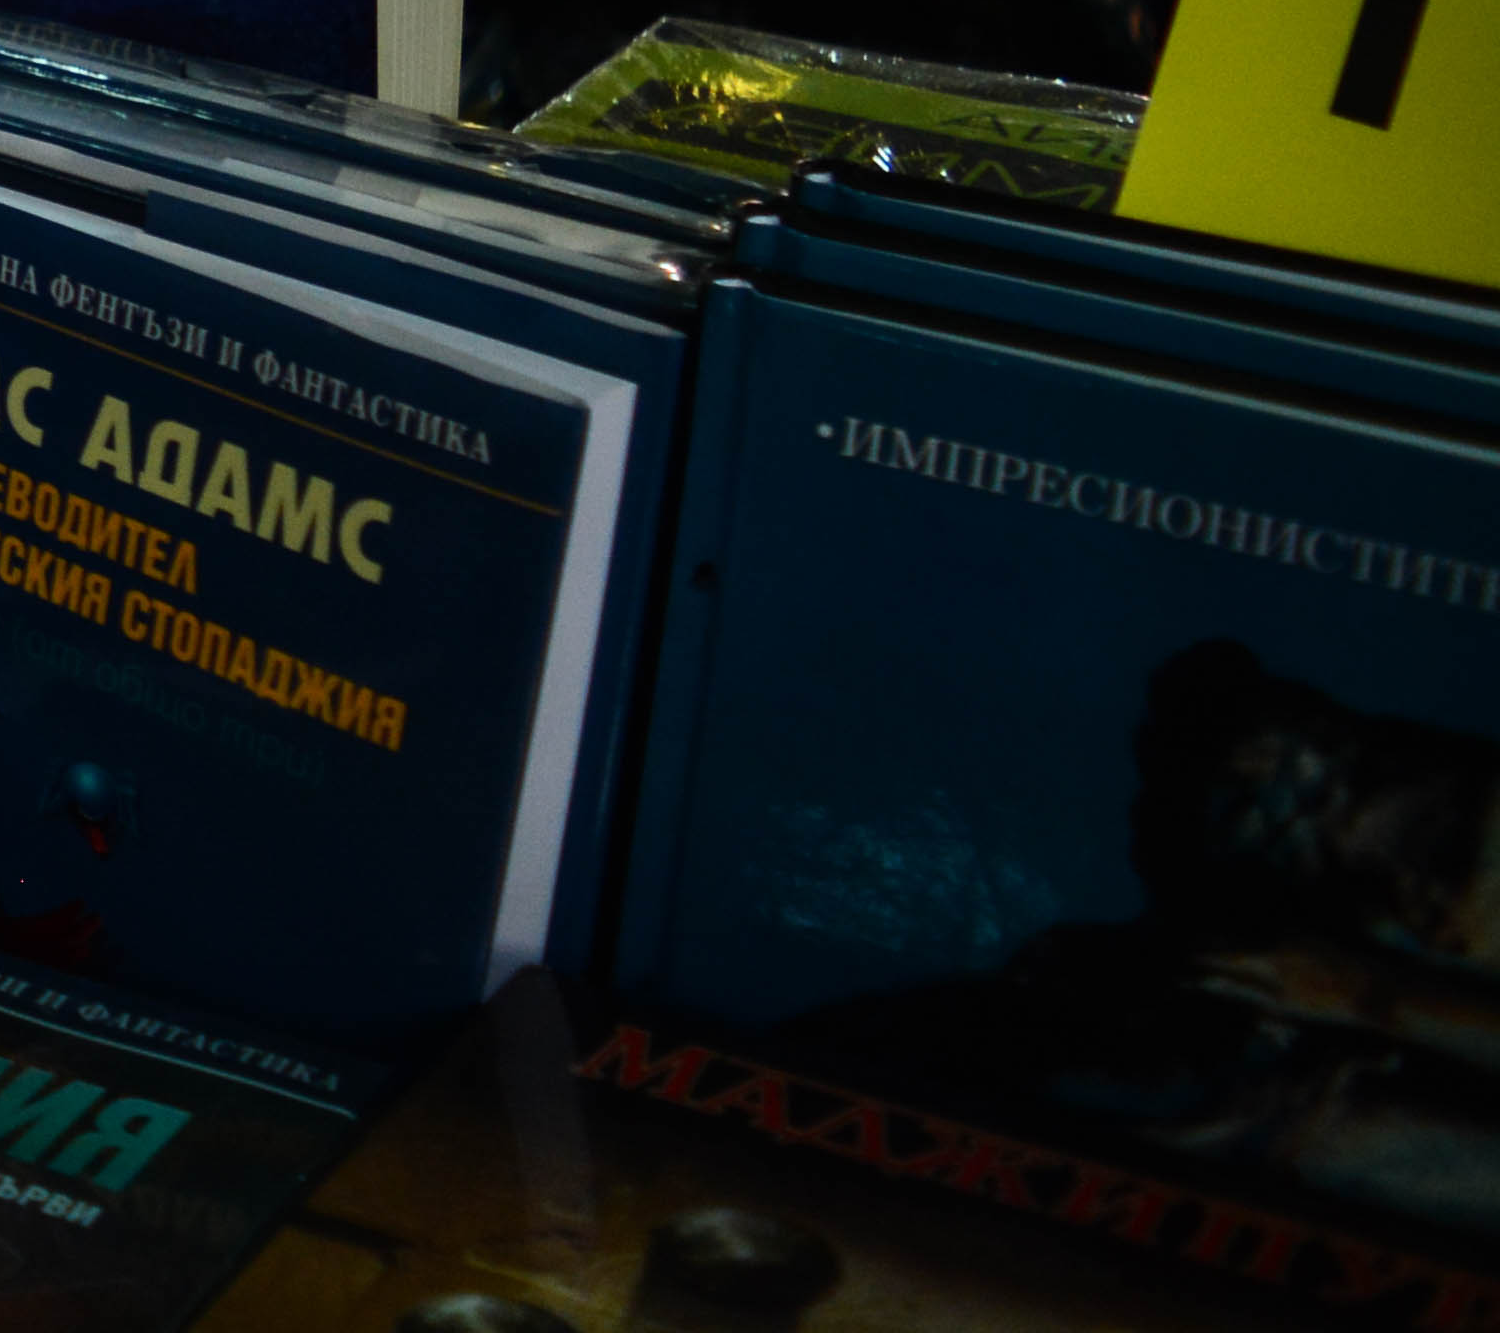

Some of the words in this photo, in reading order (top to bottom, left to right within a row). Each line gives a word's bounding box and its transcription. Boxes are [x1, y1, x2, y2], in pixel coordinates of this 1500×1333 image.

[49, 270, 210, 359] ФЕНТЪЗИ
[219, 331, 244, 372] И
[253, 346, 494, 465] ФАНТАСТИКА
[77, 394, 394, 586] АДАМС
[119, 593, 411, 753] СТОПАДЖИЯ
[36, 984, 73, 1012] И
[75, 993, 344, 1094] ФАНТАСТИКА
